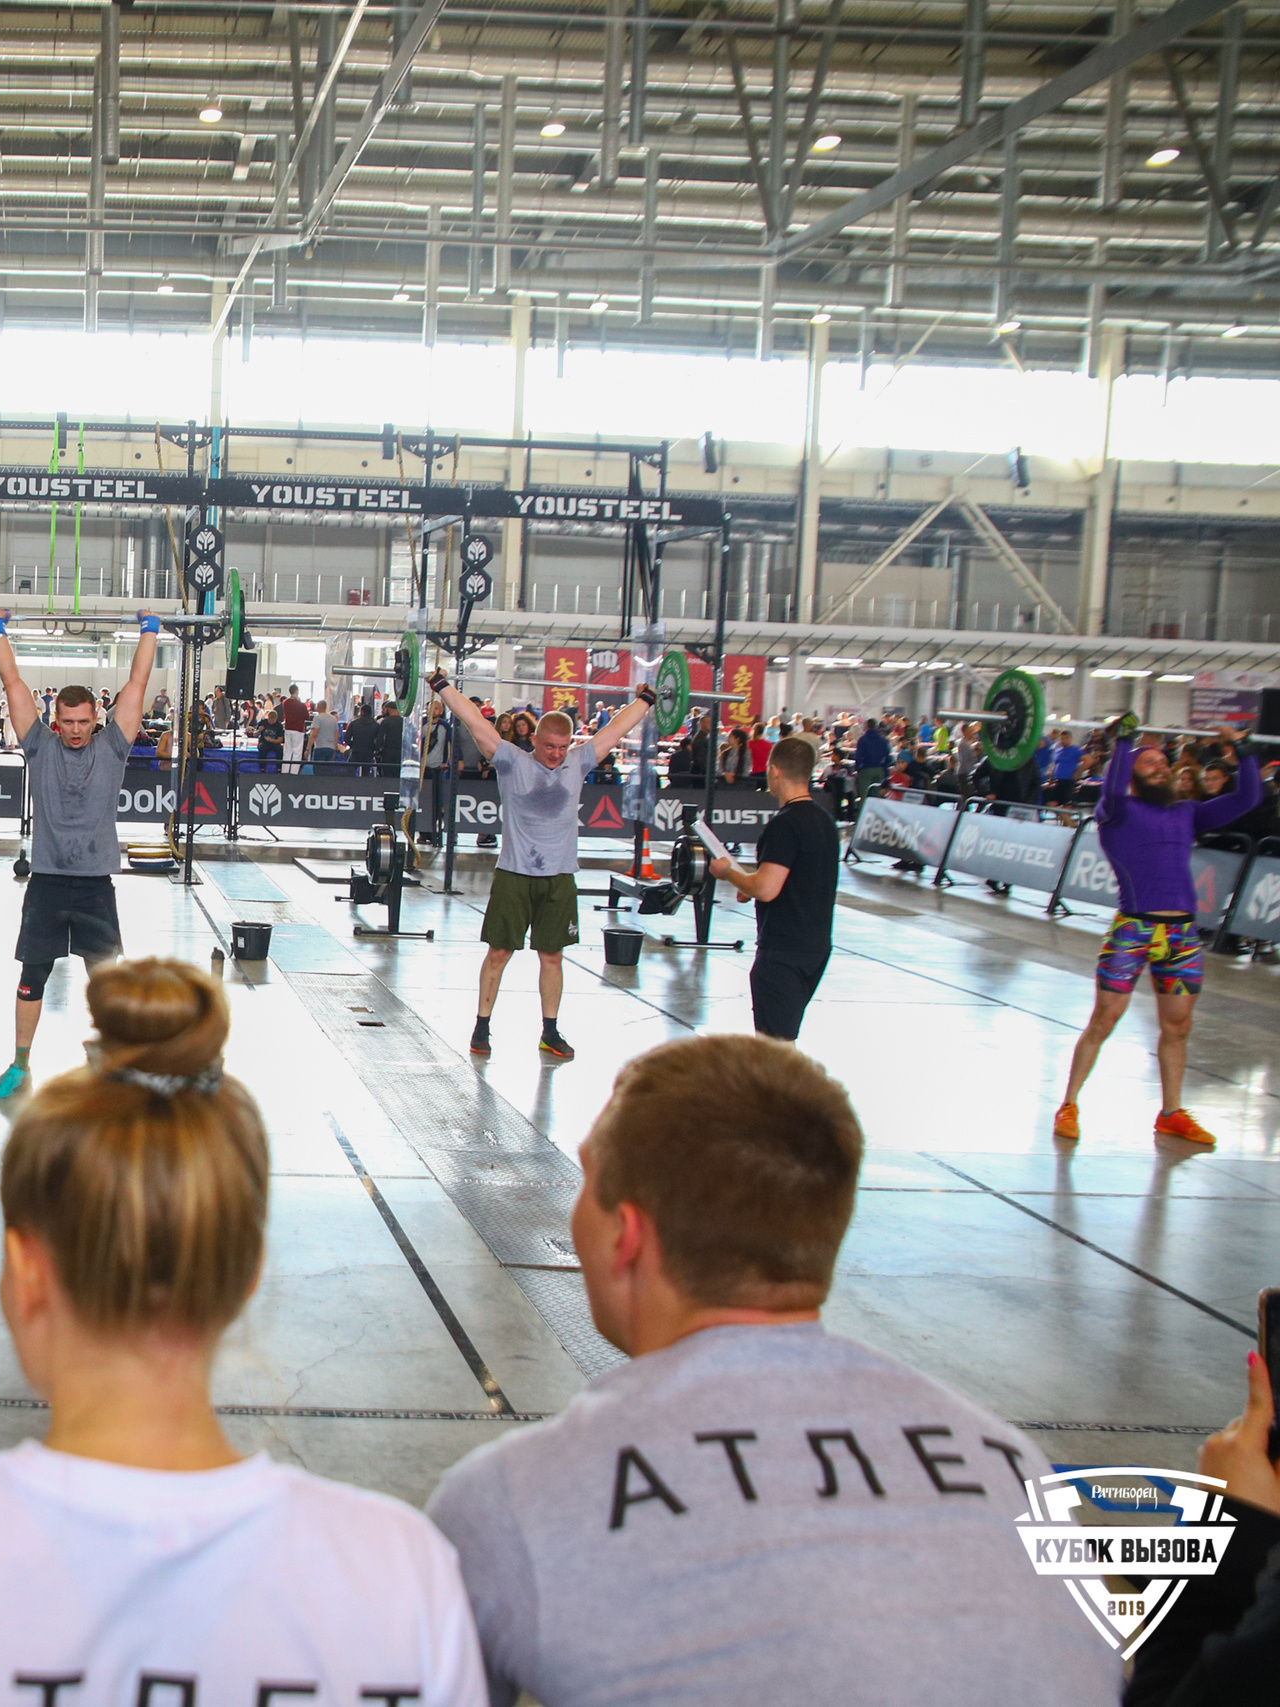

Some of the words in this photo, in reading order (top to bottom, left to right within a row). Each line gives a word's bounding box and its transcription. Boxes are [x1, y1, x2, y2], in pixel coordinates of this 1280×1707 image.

[250, 485, 422, 509] YOUSTEEL
[514, 495, 682, 521] YOUSTEEL
[856, 811, 926, 851] Reebok
[979, 835, 1056, 869] YOUSTEEL
[340, 1410, 450, 1420] YOUSTEEL
[608, 1425, 1029, 1532] АТЛЕТ
